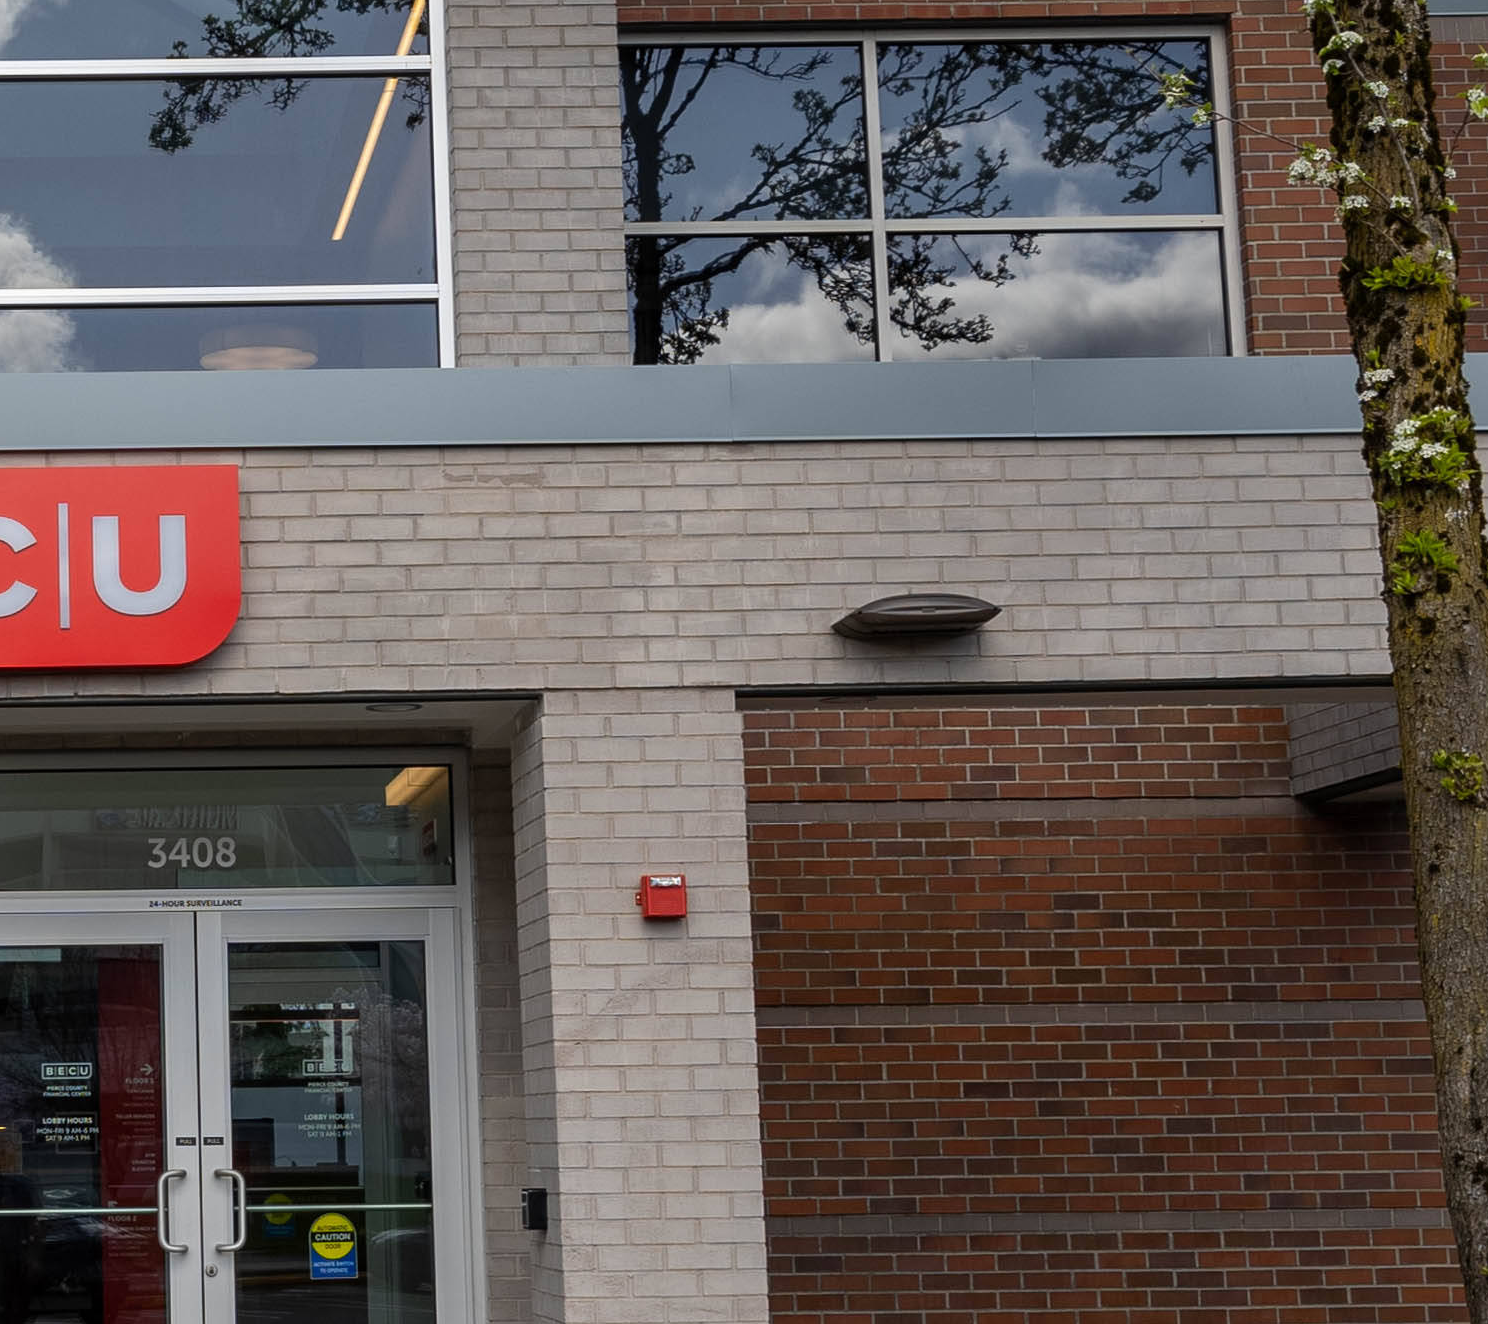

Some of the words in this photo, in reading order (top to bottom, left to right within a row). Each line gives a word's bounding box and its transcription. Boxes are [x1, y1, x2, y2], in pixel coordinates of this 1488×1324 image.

[147, 836, 237, 869] 3408
[149, 900, 185, 908] 24-HOUR
[186, 899, 243, 907] SURVEILLANCE
[46, 1066, 89, 1076] BECU
[314, 1233, 351, 1241] CAUTION
